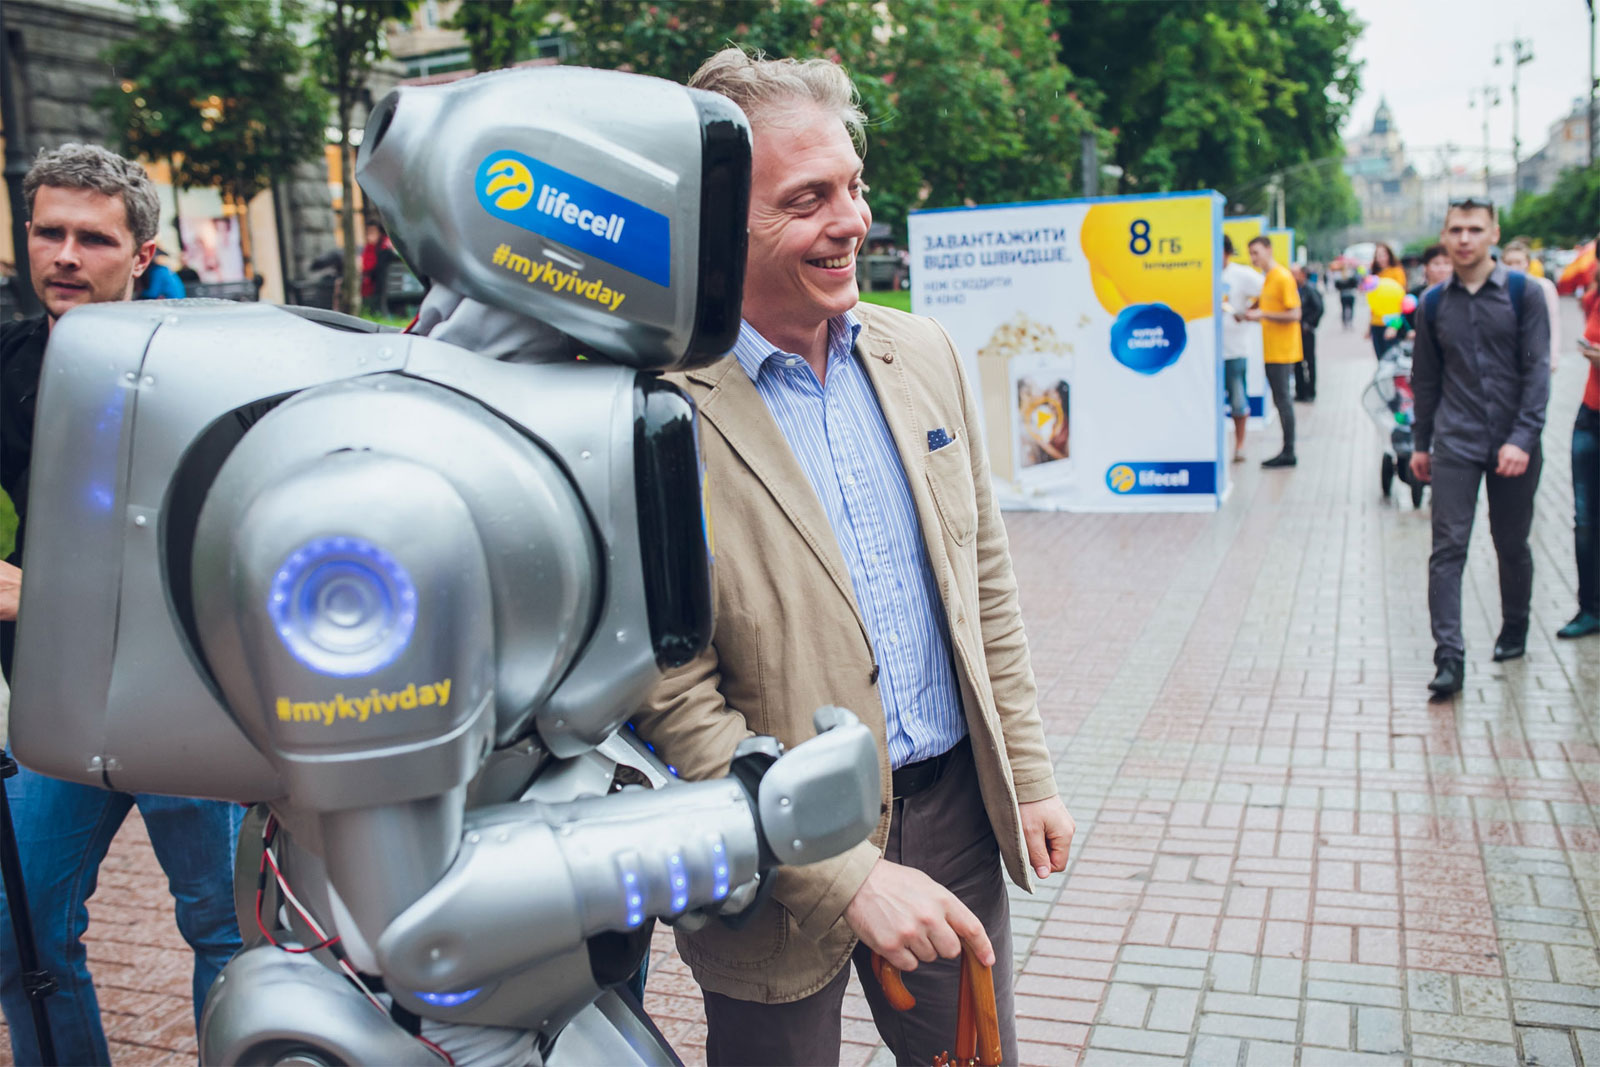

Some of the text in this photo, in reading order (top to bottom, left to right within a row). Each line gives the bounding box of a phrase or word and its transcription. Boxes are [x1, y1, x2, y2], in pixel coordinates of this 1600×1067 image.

[537, 184, 625, 243] lifecell
[924, 228, 1065, 250] ЗАВАНТАЖИТИ
[1129, 218, 1182, 256] 8 ГБ
[492, 243, 625, 311] #mykyivday
[924, 252, 976, 270] ВІДЕО
[1139, 469, 1189, 487] lifecell
[276, 678, 451, 726] #mykyivday
